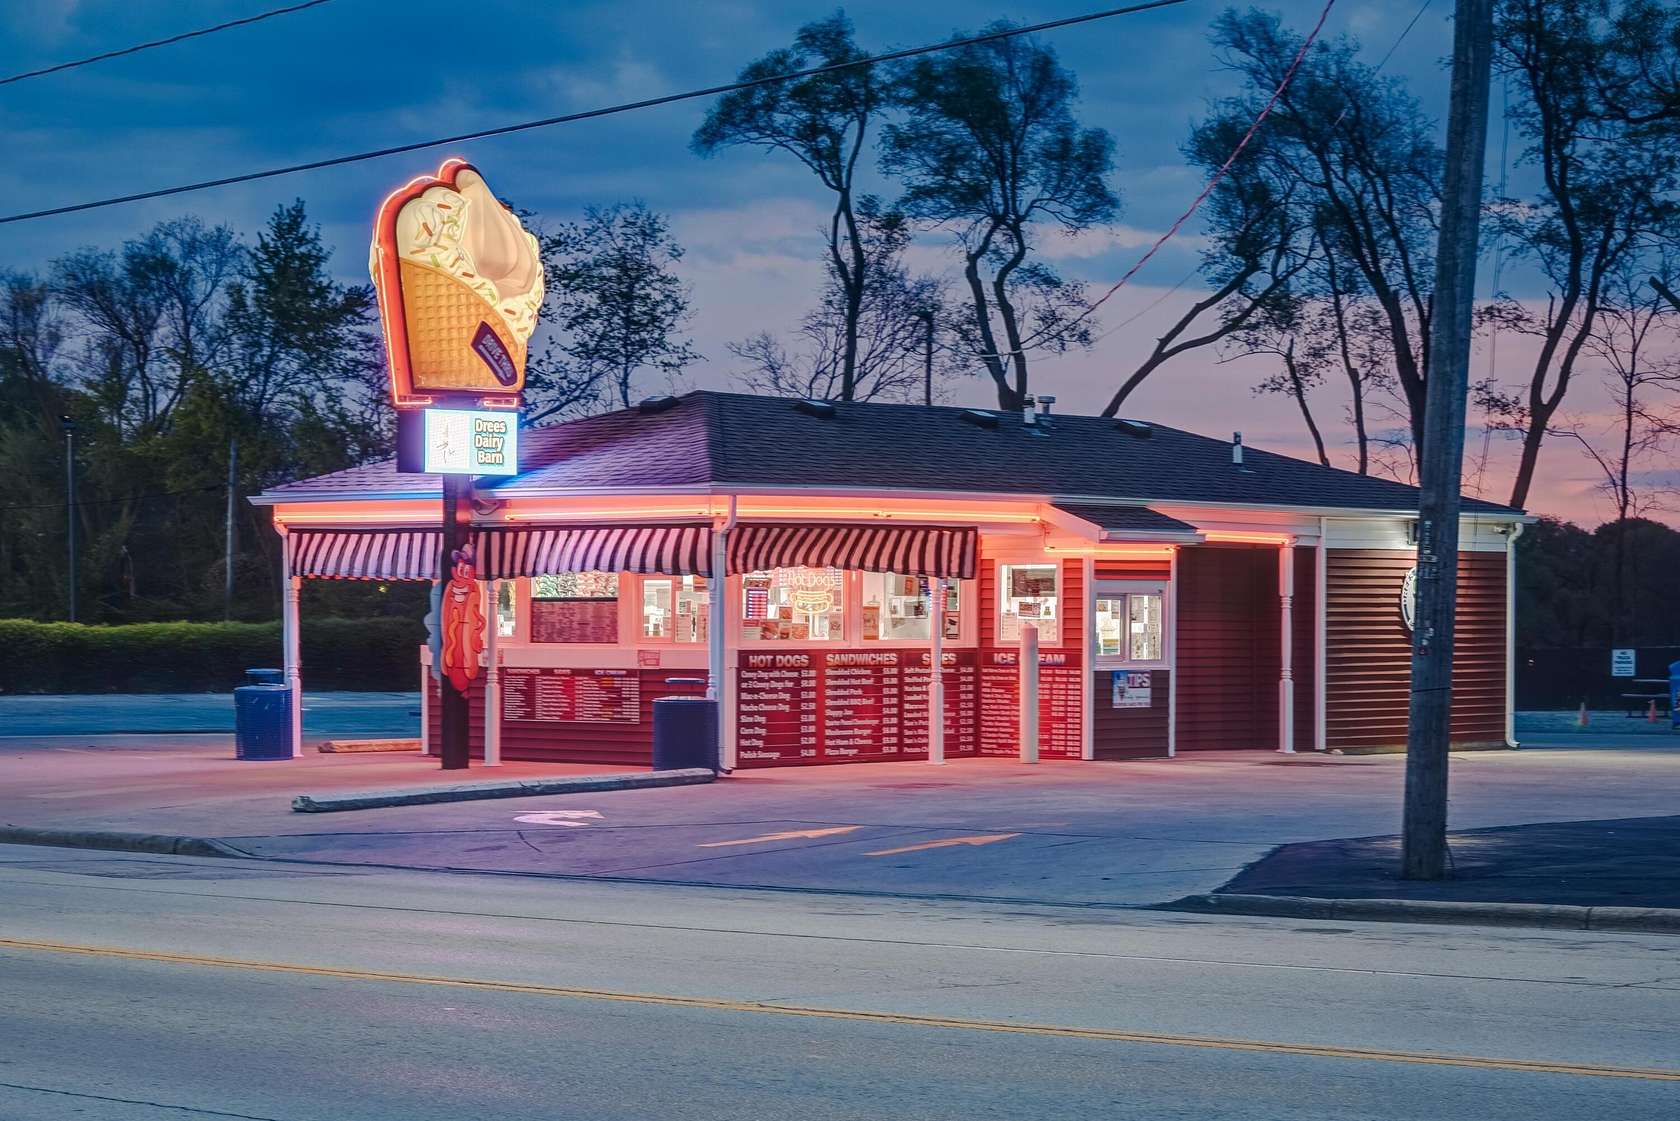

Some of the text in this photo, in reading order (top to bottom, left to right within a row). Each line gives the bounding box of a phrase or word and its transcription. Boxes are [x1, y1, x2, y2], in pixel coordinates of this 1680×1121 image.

[474, 418, 507, 434] Drees
[474, 433, 504, 452] Dairy
[476, 450, 504, 465] Barn
[749, 654, 809, 668] HOT DOGS
[826, 653, 898, 666] SANDWICHES
[922, 653, 957, 665] SES
[993, 653, 1016, 664] ICE
[1128, 673, 1151, 687] TIPS
